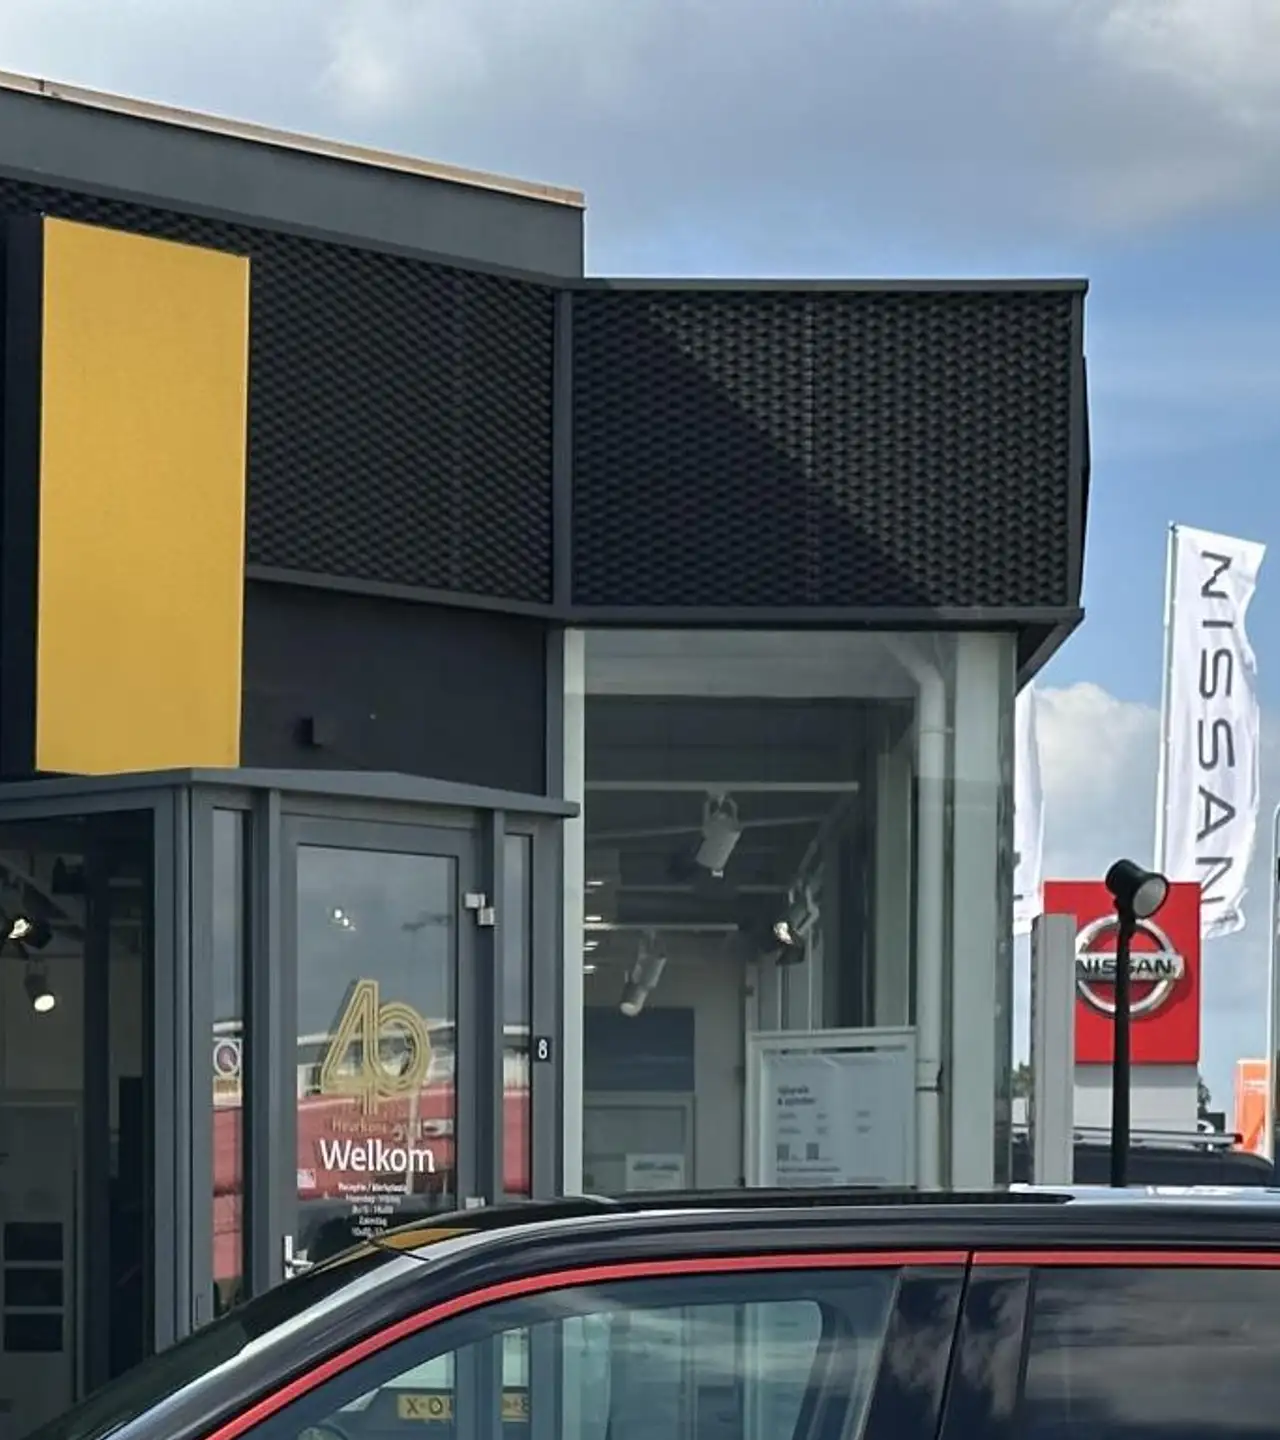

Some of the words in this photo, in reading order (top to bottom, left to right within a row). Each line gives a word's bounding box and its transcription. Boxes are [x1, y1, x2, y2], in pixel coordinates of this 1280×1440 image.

[1195, 550, 1237, 905] NISSAN
[1076, 958, 1172, 974] NISAN
[321, 979, 432, 1115] 40
[538, 1038, 548, 1060] 8
[319, 1137, 436, 1173] Welkom
